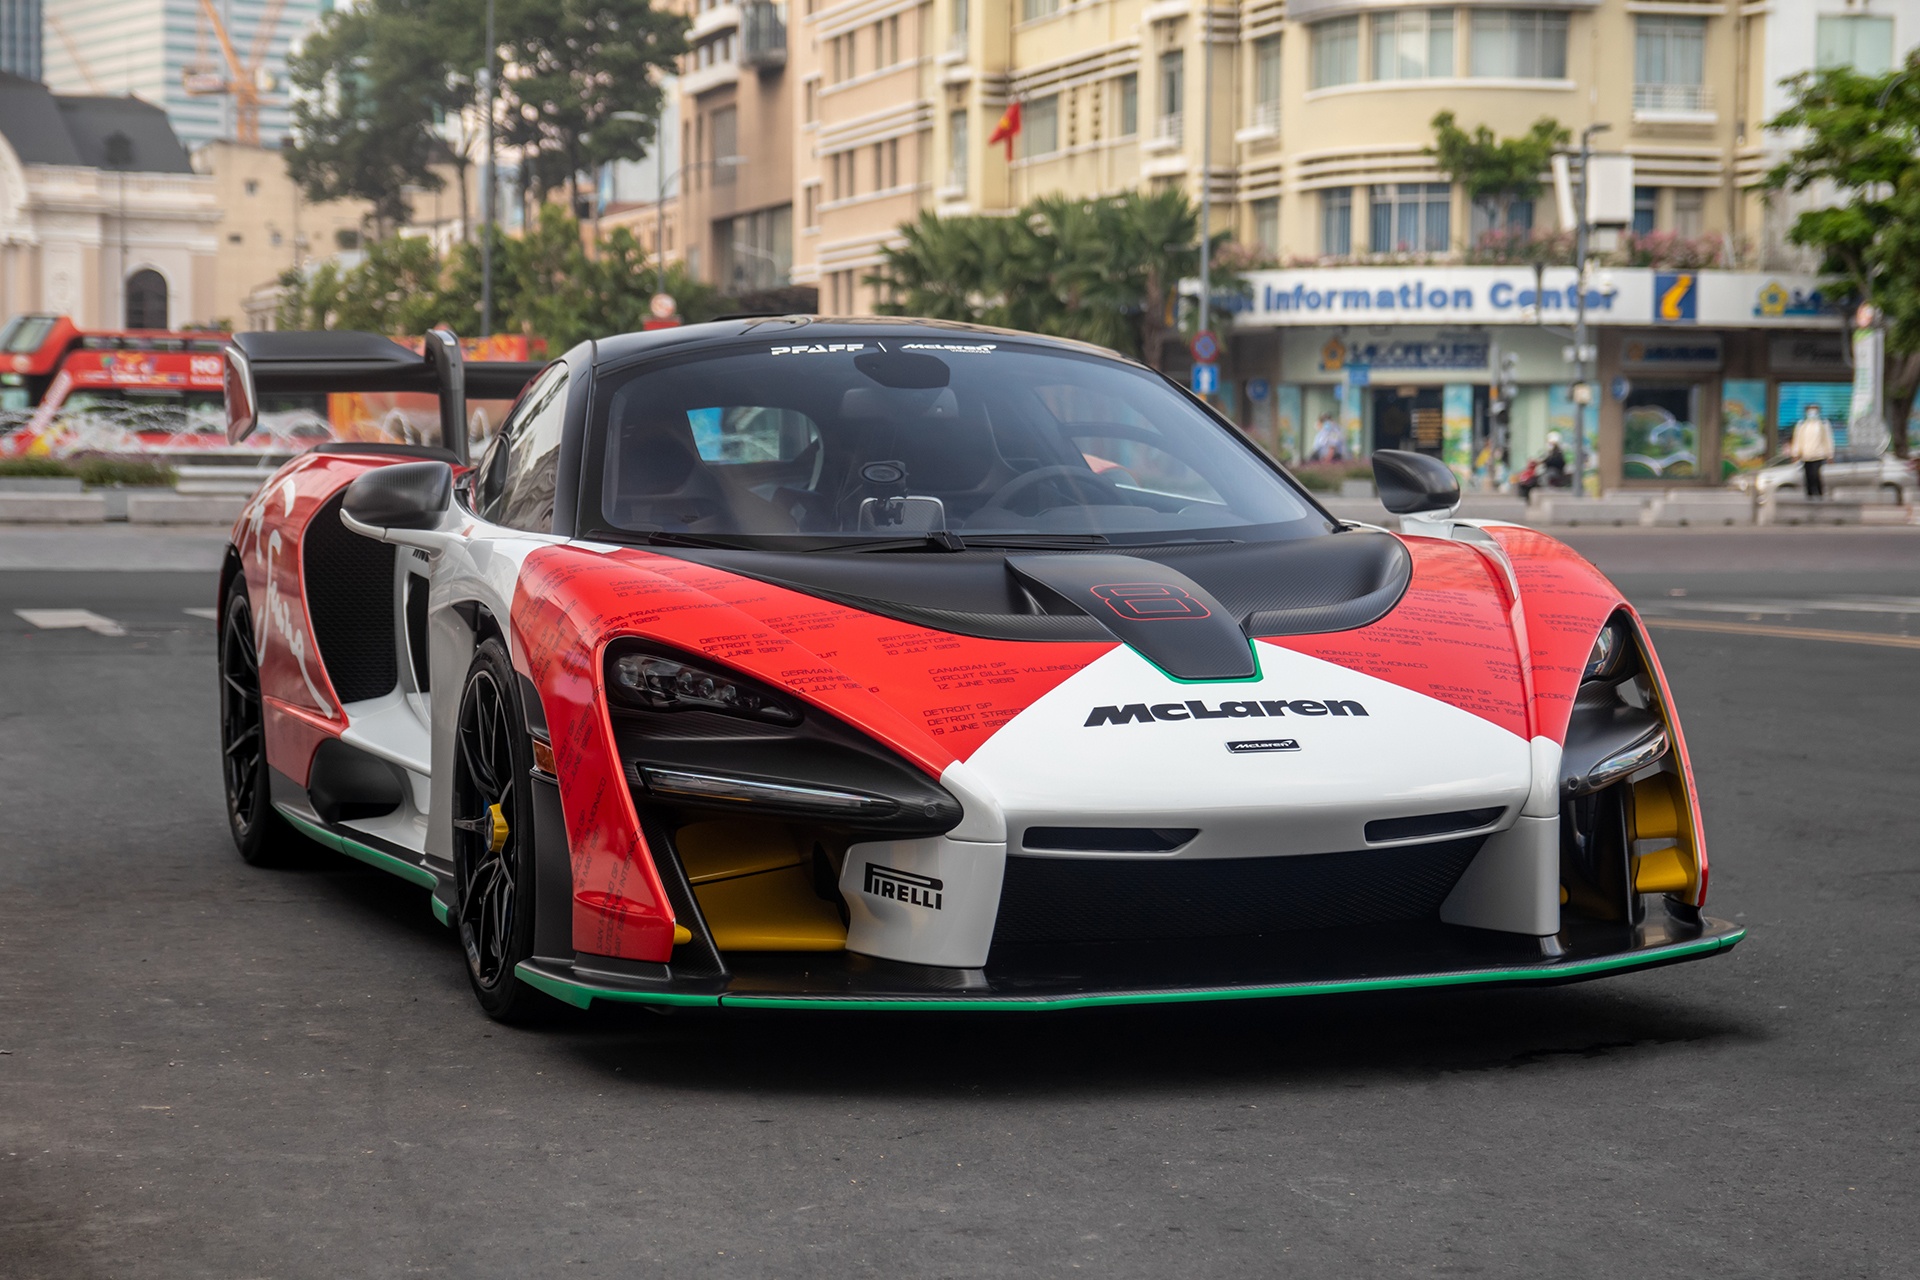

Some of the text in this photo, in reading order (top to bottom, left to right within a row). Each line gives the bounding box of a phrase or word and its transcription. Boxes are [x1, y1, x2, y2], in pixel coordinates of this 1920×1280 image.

[1264, 281, 1473, 311] Information
[1489, 282, 1618, 311] Center
[770, 343, 864, 355] PFAFF
[1089, 582, 1211, 621] 8
[588, 612, 603, 626] GP
[633, 615, 661, 625] 1985
[786, 612, 824, 621] STATES
[798, 616, 840, 625] STREET
[1412, 617, 1470, 627] NOVEMBER
[807, 623, 835, 631] 1990
[1376, 625, 1420, 635] MARINO
[699, 634, 748, 645] DETROIT
[877, 632, 922, 642] BRITISH
[1357, 629, 1424, 641] AUTODROMO
[702, 641, 752, 653] DETROIT
[881, 637, 957, 650] SILVERSTONE
[903, 646, 929, 655] JULY
[933, 643, 961, 651] 1988
[724, 649, 754, 659] JUNE
[759, 646, 785, 654] 1987
[1315, 650, 1364, 658] MONACO
[928, 661, 1006, 675] CANADIAN GP
[1381, 659, 1429, 669] MONACO
[781, 668, 833, 678] GERMAN
[932, 672, 975, 683] CIRCUIT
[979, 667, 1020, 678] GILLES
[811, 684, 837, 693] JULY
[936, 676, 1016, 691] 12 JUNE 1988
[1427, 683, 1475, 695] BELGIAN
[1434, 692, 1473, 701] CIRCUIT
[923, 702, 993, 717] DETROIT GP
[1459, 702, 1500, 713] AUGUST
[927, 713, 976, 727] DETROIT
[1083, 700, 1370, 728] McLaren
[931, 727, 945, 737] 19
[948, 722, 979, 734] JUNE
[1234, 740, 1293, 749] McLaren
[586, 775, 607, 825] MONACO
[580, 851, 593, 877] MAY
[609, 860, 620, 879] GP
[863, 862, 944, 911] PIRELLI
